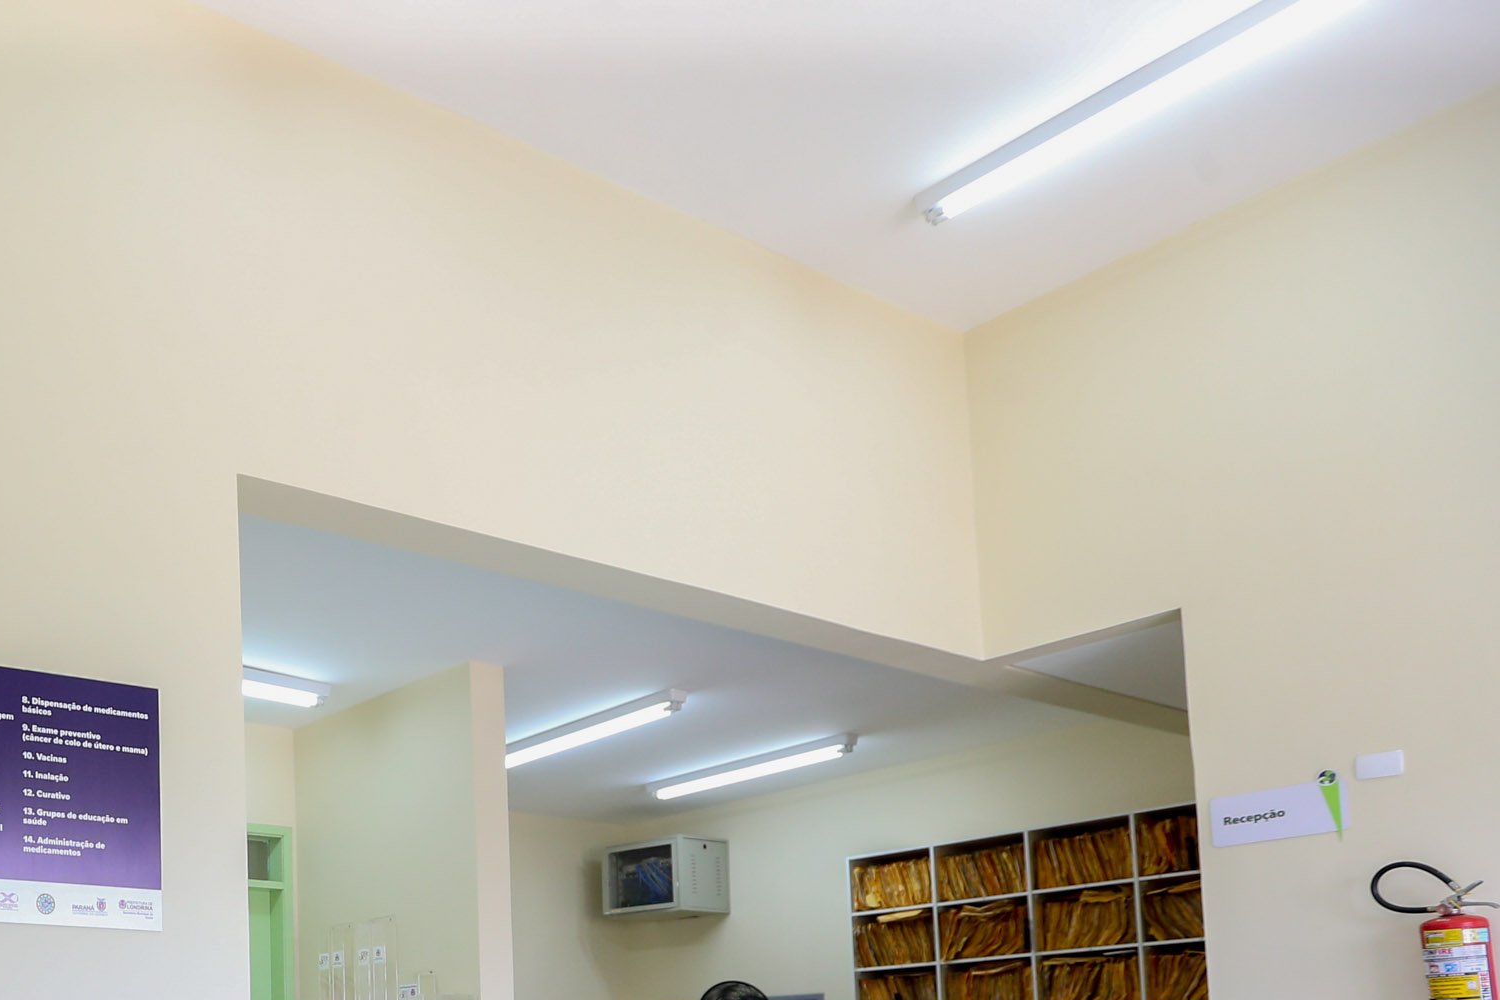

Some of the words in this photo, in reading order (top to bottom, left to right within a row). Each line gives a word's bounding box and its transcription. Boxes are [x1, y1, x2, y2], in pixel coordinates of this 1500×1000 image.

[22, 696, 30, 704] 8.
[32, 697, 81, 711] Dispensação
[83, 704, 92, 712] de
[94, 706, 148, 720] medicamentos
[22, 705, 52, 716] básicos
[22, 723, 30, 732] 9.
[32, 724, 58, 735] Exame
[60, 729, 101, 740] preventivo
[22, 733, 52, 743] (câncer
[64, 738, 81, 747] colo
[83, 740, 92, 748] de
[94, 741, 114, 751] útero
[122, 745, 148, 756] mama)
[22, 751, 34, 760] 10.
[36, 752, 67, 763] Vacinas
[23, 770, 33, 778] 11.
[35, 771, 69, 782] Inalação
[23, 788, 34, 797] 12.
[36, 790, 71, 800] Curativo
[23, 807, 35, 815] 13.
[36, 808, 65, 819] Grupos
[78, 813, 115, 824] educação
[23, 817, 47, 826] saúde
[1223, 809, 1285, 826] Recepção
[23, 835, 35, 844] 14.
[37, 836, 94, 849] Administração
[23, 845, 81, 857] medicamentos
